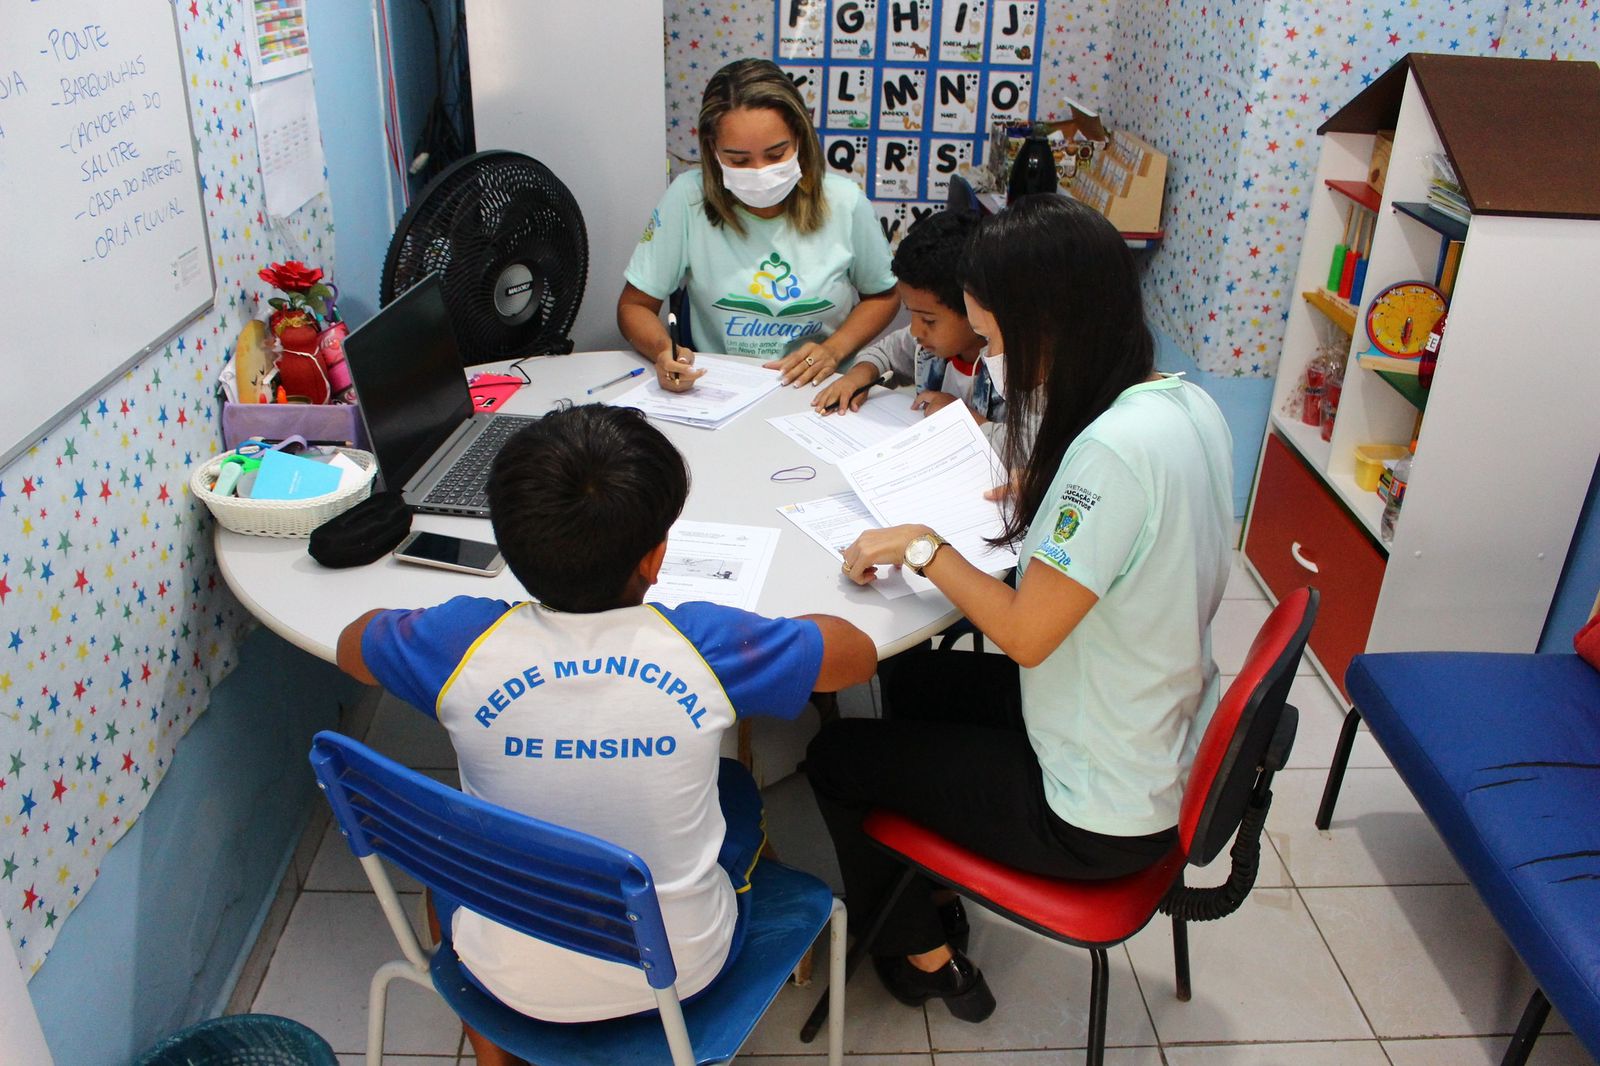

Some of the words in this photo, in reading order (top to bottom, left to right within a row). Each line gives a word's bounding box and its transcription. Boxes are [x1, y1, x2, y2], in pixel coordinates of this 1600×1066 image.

[836, 2, 865, 33] G
[893, 1, 919, 32] H
[955, 3, 968, 33] I
[1002, 4, 1019, 36] J
[143, 92, 161, 109] DO
[838, 71, 855, 101] L
[884, 74, 919, 110] M
[940, 74, 966, 105] N
[991, 80, 1019, 111] O
[81, 141, 140, 182] SALITRE
[827, 140, 856, 173] Q
[884, 142, 907, 172] R
[936, 143, 957, 173] S
[122, 178, 140, 196] DO
[134, 197, 185, 236] FLUVIAL
[725, 316, 823, 339] Educação
[474, 665, 546, 729] REDE
[554, 656, 710, 729] MUNICIPAL
[504, 736, 544, 758] DE
[554, 736, 676, 759] ENSINO
